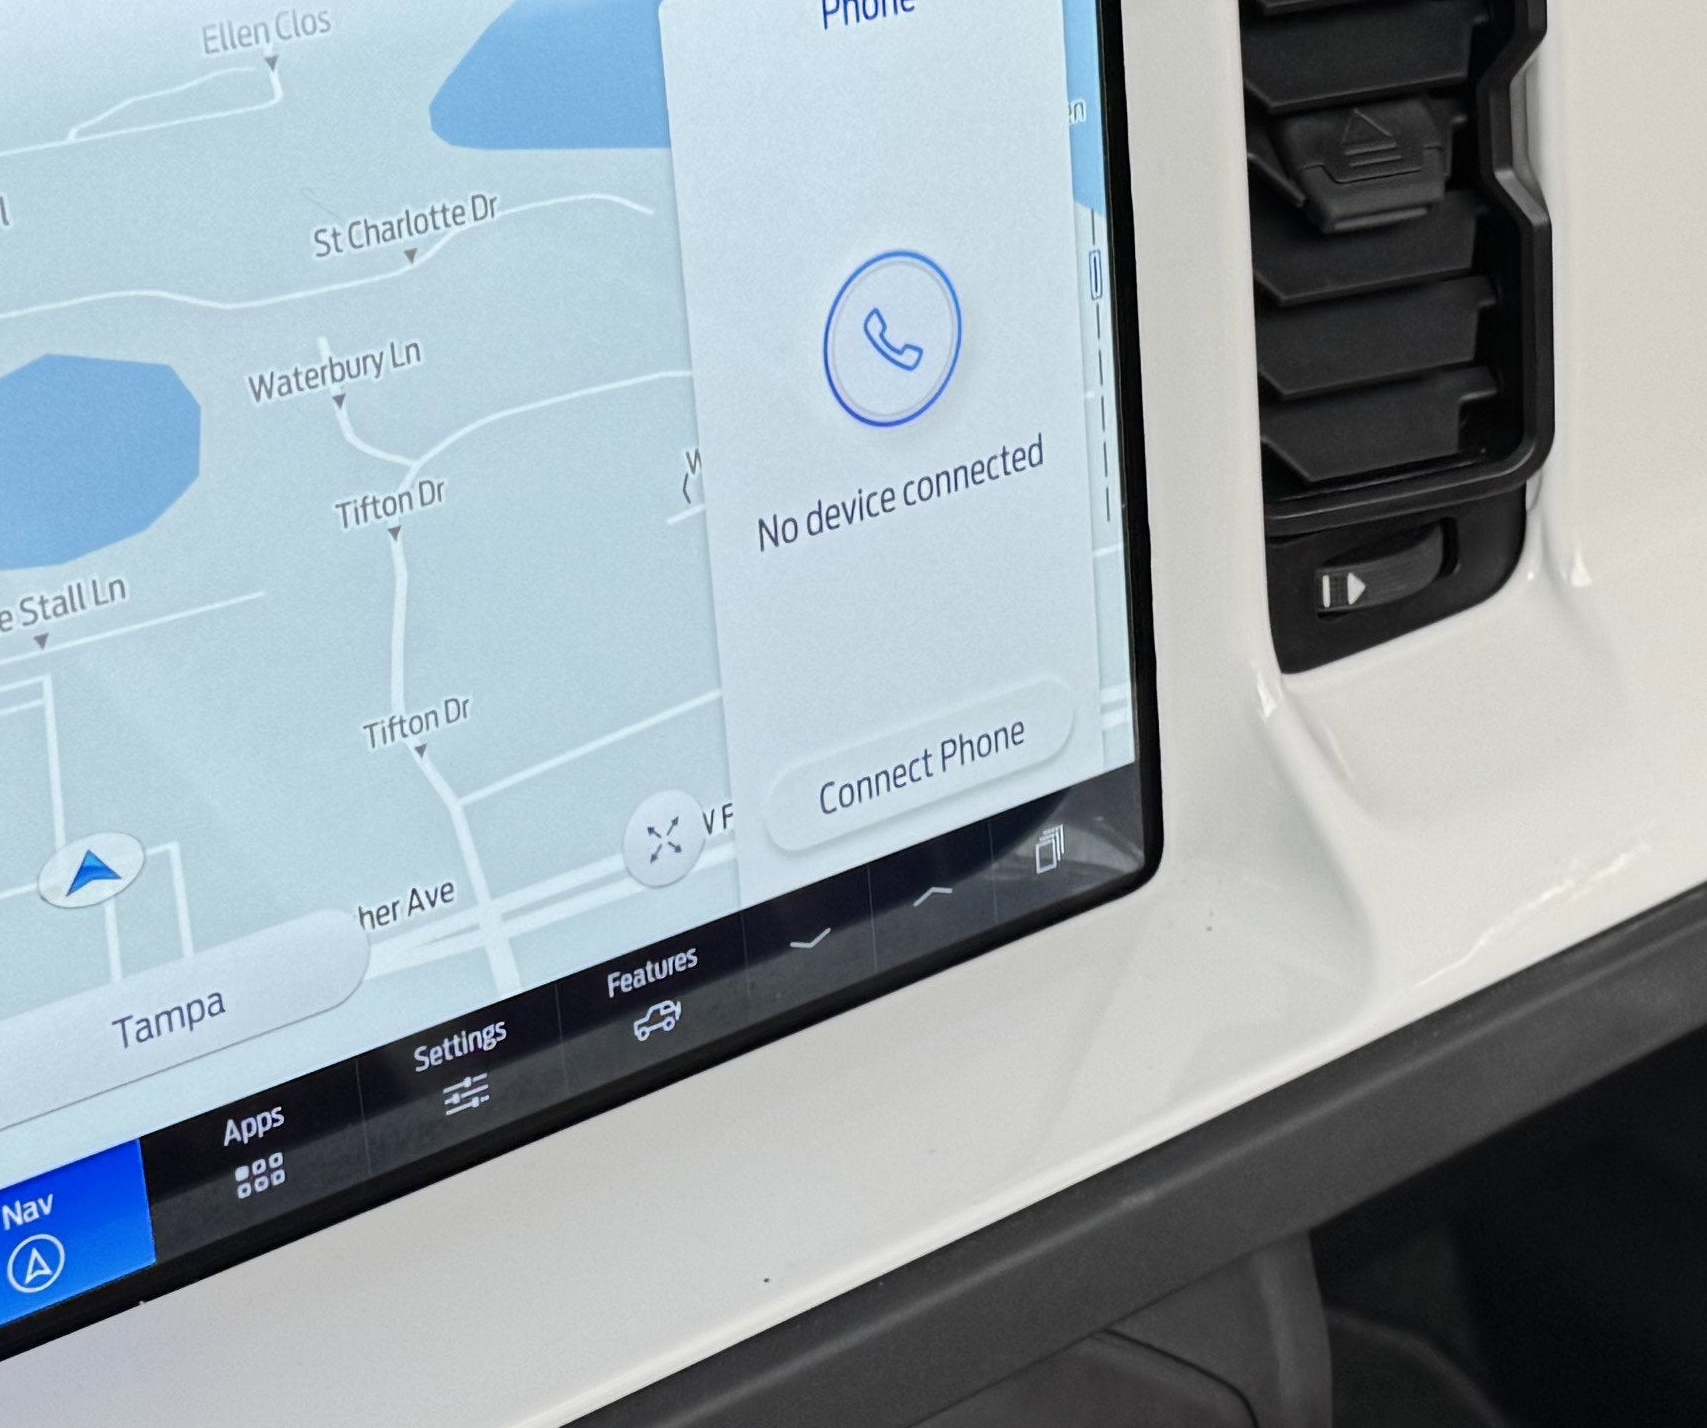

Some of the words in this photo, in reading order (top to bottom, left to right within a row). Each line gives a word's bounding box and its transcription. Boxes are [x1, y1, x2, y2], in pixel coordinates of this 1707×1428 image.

[202, 17, 270, 55] Ellen
[275, 7, 332, 42] Clos
[313, 226, 344, 258] St
[349, 202, 466, 251] Charlotte
[470, 194, 497, 222] Dr
[248, 347, 385, 403] Waterbury
[389, 339, 422, 369] Ln
[334, 486, 413, 530] Tifton
[417, 480, 445, 510] Dr
[757, 518, 799, 552] No
[805, 483, 897, 538] device
[902, 433, 1045, 507] connected
[19, 586, 85, 628] Stall
[92, 576, 127, 608] Ln
[364, 706, 441, 751] Tifton
[444, 697, 472, 725] Dr
[819, 749, 934, 816] Connect
[940, 717, 1026, 772] Phone
[407, 882, 455, 917] Ave
[607, 946, 698, 998] Features
[113, 991, 227, 1052] Tampa
[414, 1020, 507, 1073] Settings
[223, 1106, 285, 1148] Apps
[1, 1192, 54, 1232] Nav
